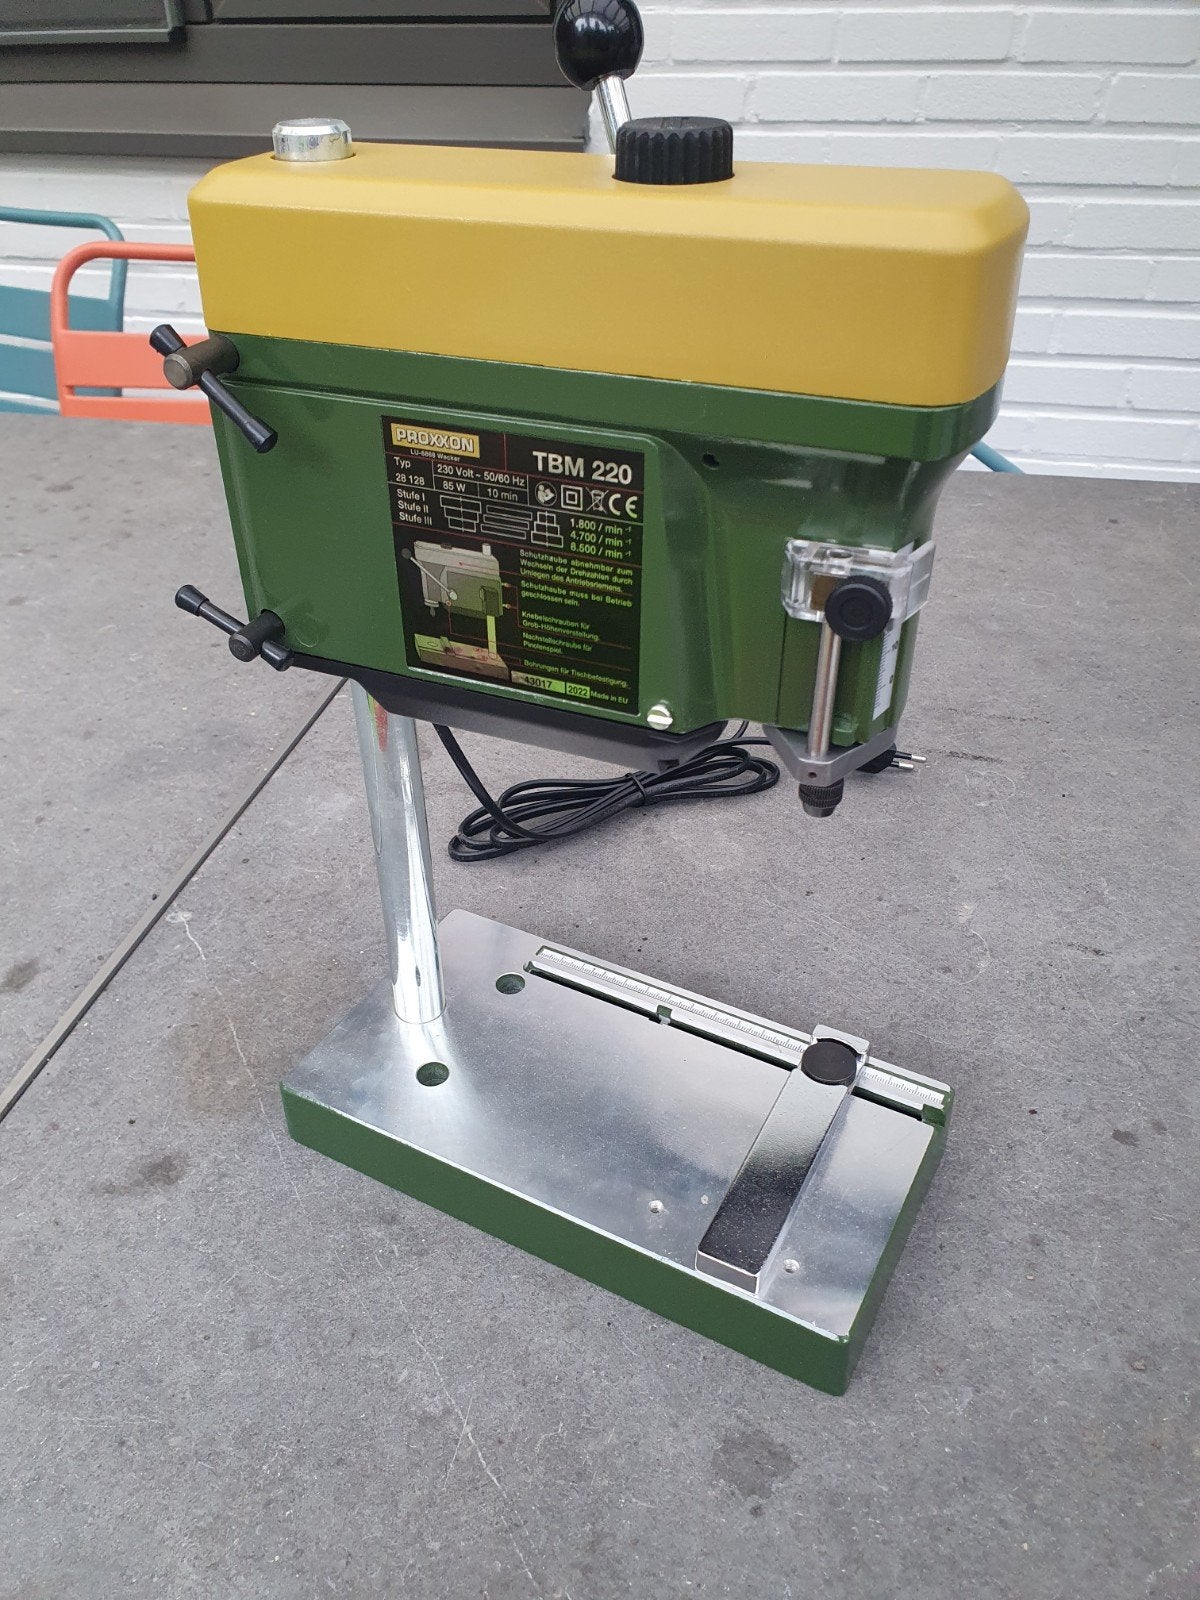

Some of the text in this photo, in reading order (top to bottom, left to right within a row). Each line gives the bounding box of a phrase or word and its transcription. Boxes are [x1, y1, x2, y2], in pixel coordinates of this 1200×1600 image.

[396, 428, 475, 453] PROXXON
[394, 456, 411, 469] Typ
[532, 451, 632, 485] TBM 220
[437, 464, 454, 475] 230
[455, 466, 475, 479] Volt
[483, 471, 510, 484] 50/60
[512, 475, 525, 486] Hz
[396, 488, 420, 501] Stufe
[442, 480, 466, 493] 85 W
[487, 488, 518, 502] 10 min
[397, 500, 429, 513] Stufe II
[398, 511, 433, 525] Stufe III
[570, 518, 596, 531] 1.800
[604, 525, 623, 535] min
[569, 530, 596, 543] 4.700
[604, 537, 623, 548] min
[570, 541, 596, 555] 8.500
[604, 549, 623, 559] min
[519, 549, 633, 576] Schutzhaube abnehmbar zum
[520, 558, 633, 585] Wechseln der Drehzahlen durch
[520, 567, 551, 580] Umlegen
[551, 573, 565, 582] des
[520, 580, 633, 607] Schutzhaube muss bei Betrieb
[520, 590, 563, 604] geschlossen
[521, 611, 591, 630] Knebelschrauben für
[582, 642, 593, 652] für
[523, 659, 560, 673] Bohrungen
[560, 666, 571, 676] für
[524, 675, 553, 689] 43017
[568, 685, 588, 697] 2022
[590, 689, 629, 705] Made in EU
